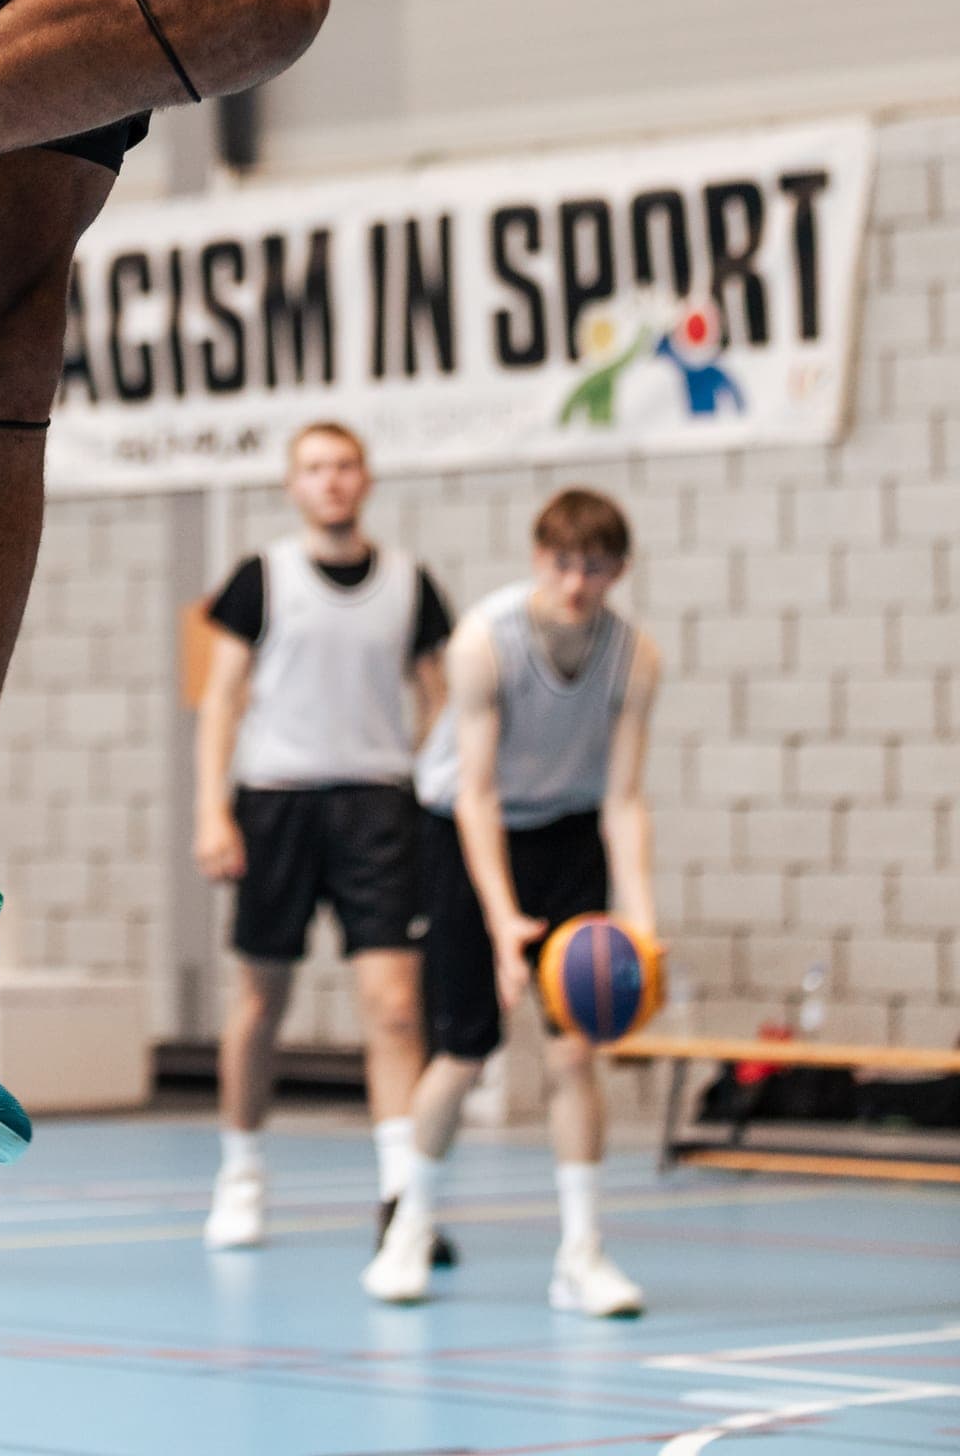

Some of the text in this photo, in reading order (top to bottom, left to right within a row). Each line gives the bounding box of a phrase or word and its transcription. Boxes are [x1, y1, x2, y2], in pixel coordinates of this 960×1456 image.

[57, 228, 336, 405] ACISM
[369, 212, 456, 379] IN
[490, 170, 829, 372] SPORT
